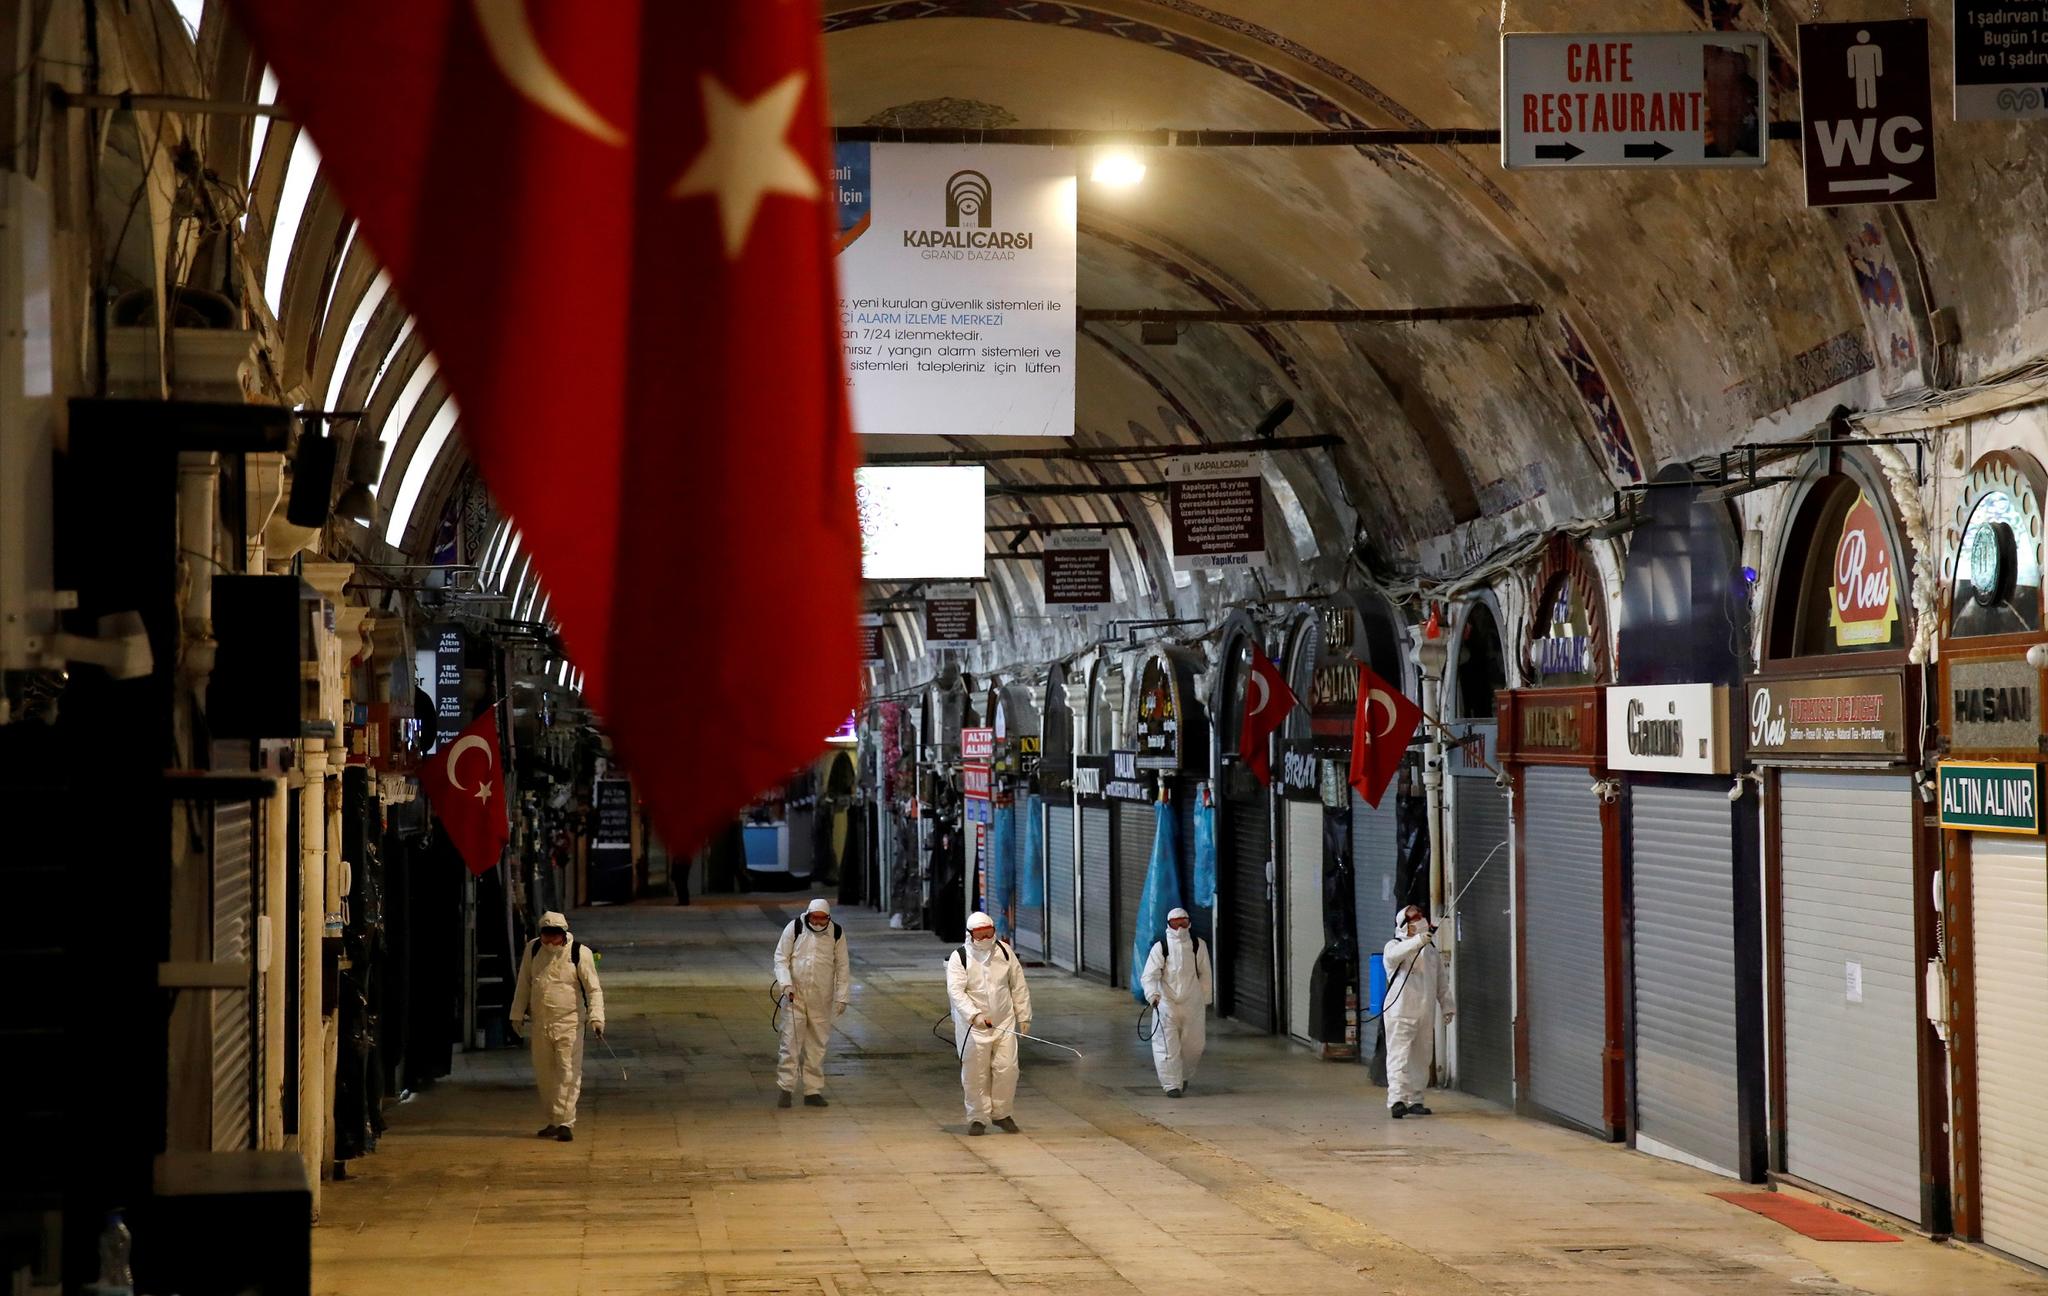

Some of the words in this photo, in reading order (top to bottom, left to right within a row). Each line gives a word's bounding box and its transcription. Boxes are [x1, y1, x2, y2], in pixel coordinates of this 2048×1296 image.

[1977, 9, 2039, 28] şadırvan
[1984, 30, 2028, 48] Bugün
[1567, 43, 1634, 84] CAFE
[1979, 54, 1996, 66] ve
[2008, 51, 2048, 69] şadır
[1522, 91, 1703, 133] RESTAURANT
[1815, 115, 1925, 168] WC
[921, 249, 965, 260] GRAND
[967, 250, 1016, 261] BAZAAR
[852, 298, 879, 310] yeni
[882, 298, 928, 309] kurulan
[931, 299, 983, 312] güvenlik
[986, 299, 1044, 311] sistemleri
[1047, 300, 1061, 311] ile
[857, 313, 901, 324] ALARM
[905, 311, 947, 325] İZLEME
[951, 313, 1003, 325] MERKEZİ
[863, 328, 891, 340] 7/24
[895, 329, 983, 341] izlenmektedir.
[887, 346, 932, 358] yangın
[938, 346, 976, 356] alarm
[981, 346, 1040, 357] sistemleri
[1045, 349, 1061, 358] ve
[850, 360, 909, 371] sistemleri
[918, 361, 986, 373] talepleriniz
[994, 362, 1017, 375] için
[1025, 362, 1061, 373] lütfen
[1838, 529, 1889, 612] Reis
[1954, 687, 2031, 723] HASAN
[1751, 687, 1786, 747] Reis
[1789, 697, 1834, 723] TURKISH
[1835, 694, 1884, 723] DELIGHT
[1943, 777, 1981, 815] ALTIN
[1984, 778, 2033, 818] ALINIR
